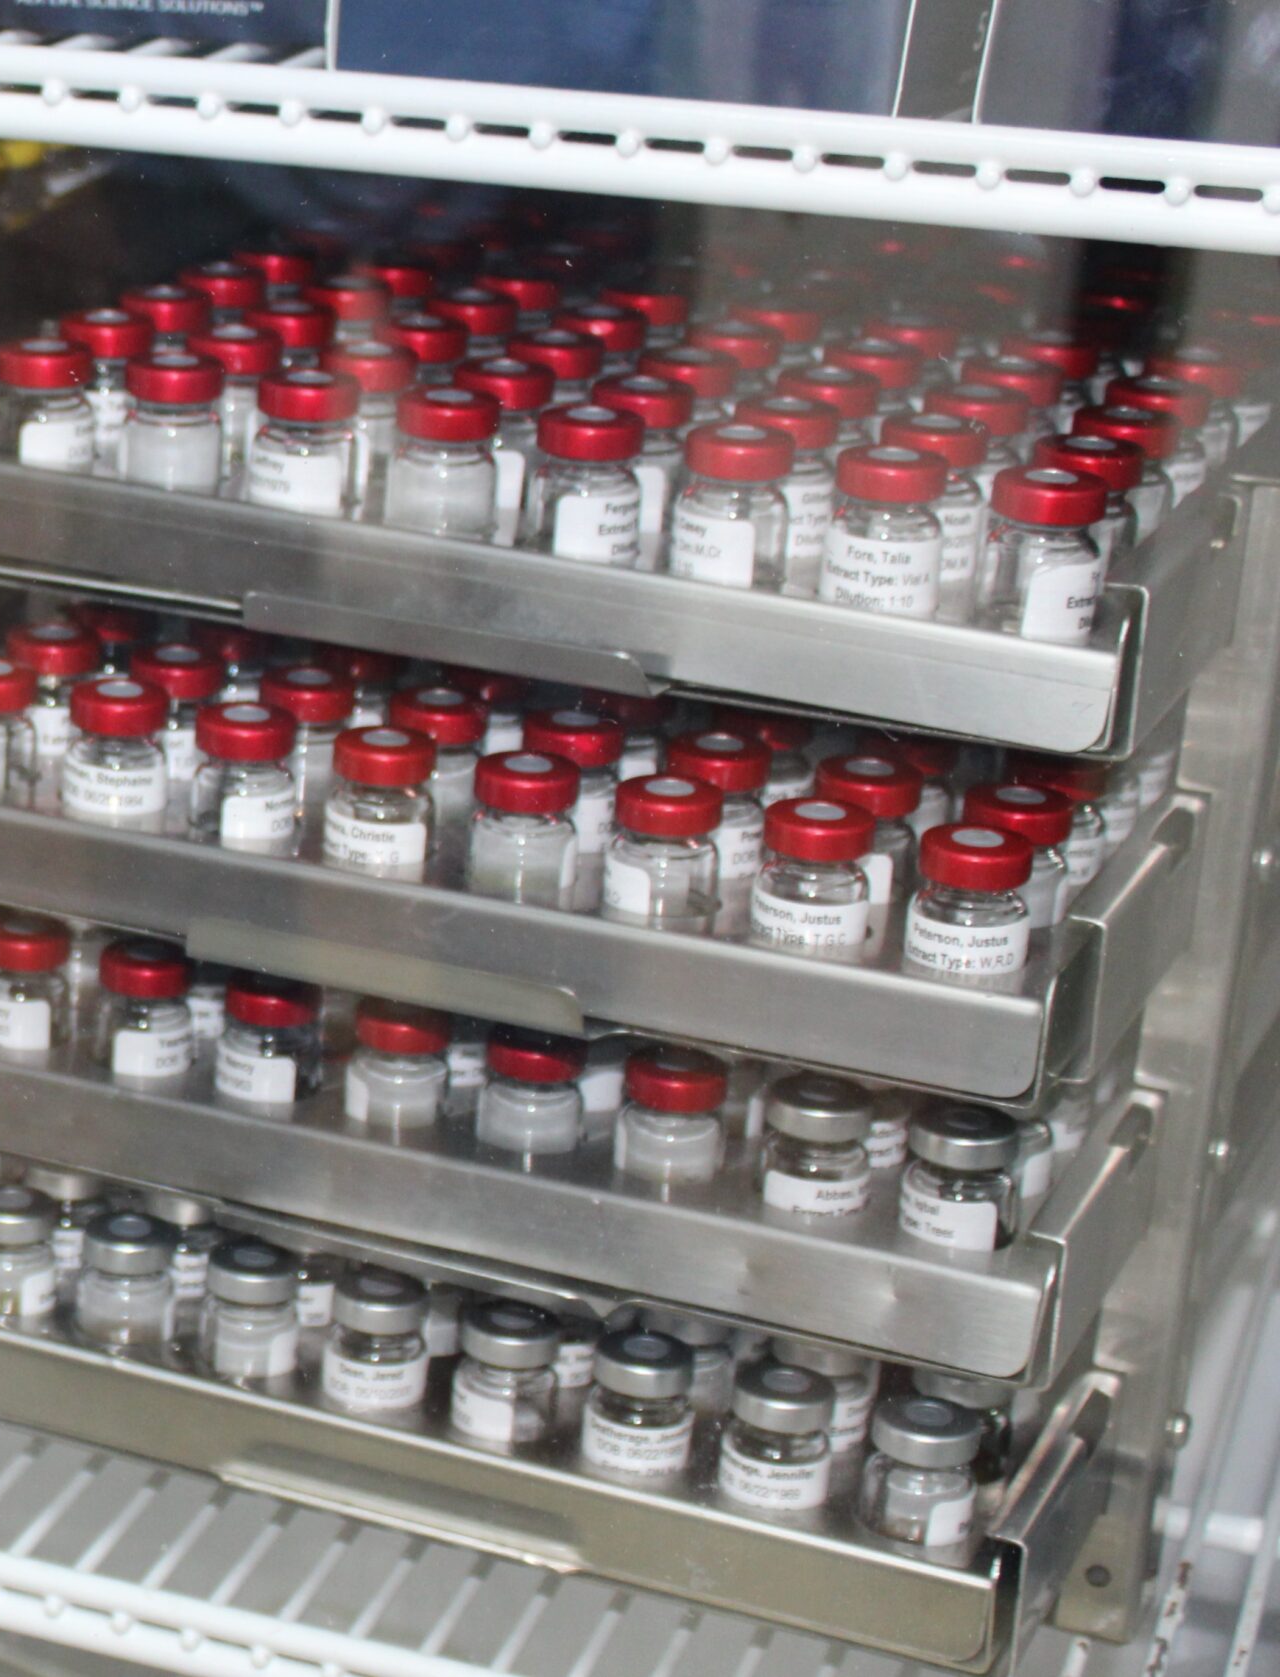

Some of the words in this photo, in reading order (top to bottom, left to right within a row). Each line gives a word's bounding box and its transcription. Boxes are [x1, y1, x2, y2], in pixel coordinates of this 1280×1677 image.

[847, 544, 876, 564] Fore,
[882, 551, 911, 565] Talia
[863, 570, 898, 588] Type:
[835, 585, 884, 609] Dilution:
[351, 826, 395, 842] Christie
[801, 912, 842, 926] Justus
[913, 921, 964, 949] Peterson,
[967, 936, 1009, 949] Justus
[940, 953, 977, 972] Type:
